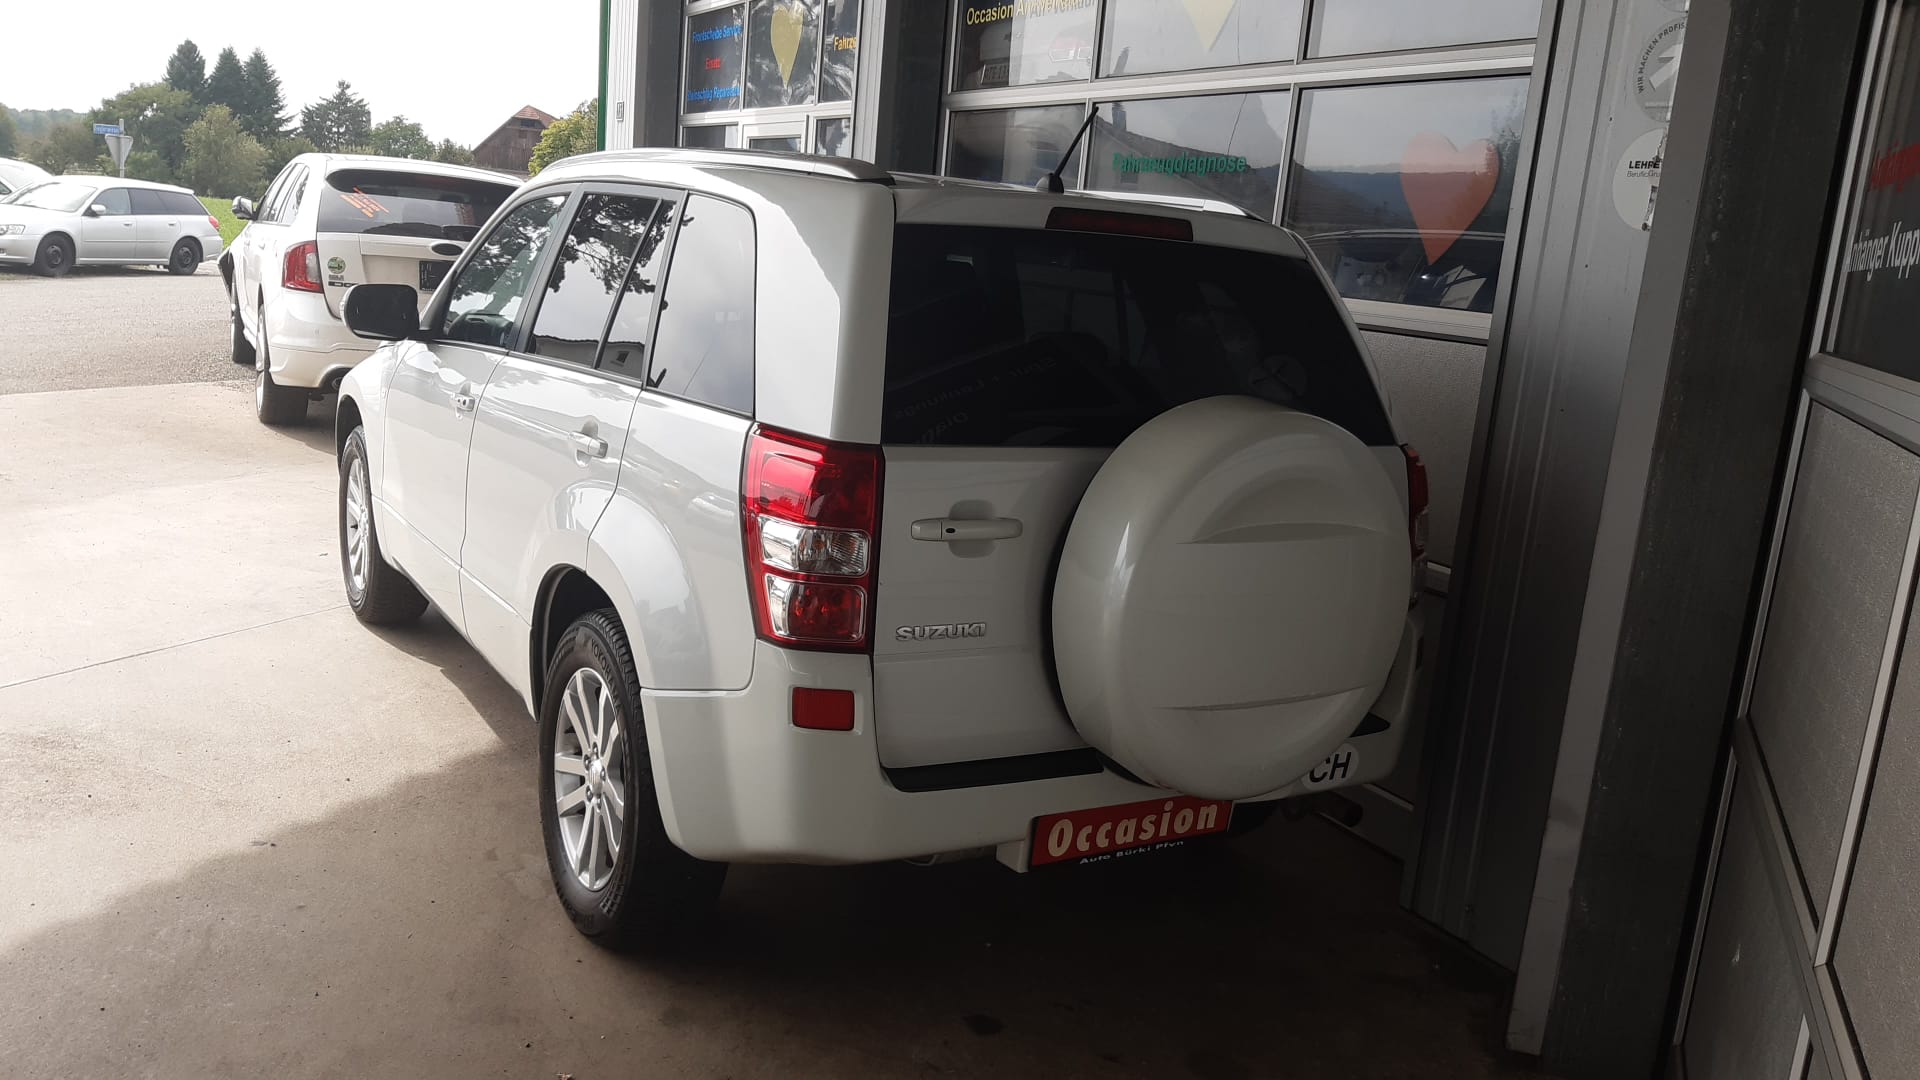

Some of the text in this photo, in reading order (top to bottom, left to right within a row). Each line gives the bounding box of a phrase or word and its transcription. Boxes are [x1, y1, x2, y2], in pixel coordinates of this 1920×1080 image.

[966, 3, 1013, 25] Occasion
[1638, 38, 1659, 74] MACHEN
[1112, 151, 1248, 177] Fahrzeugdiagnose
[896, 622, 986, 641] SUZUKI
[1047, 800, 1217, 858] Occasion
[1079, 854, 1111, 865] Auto
